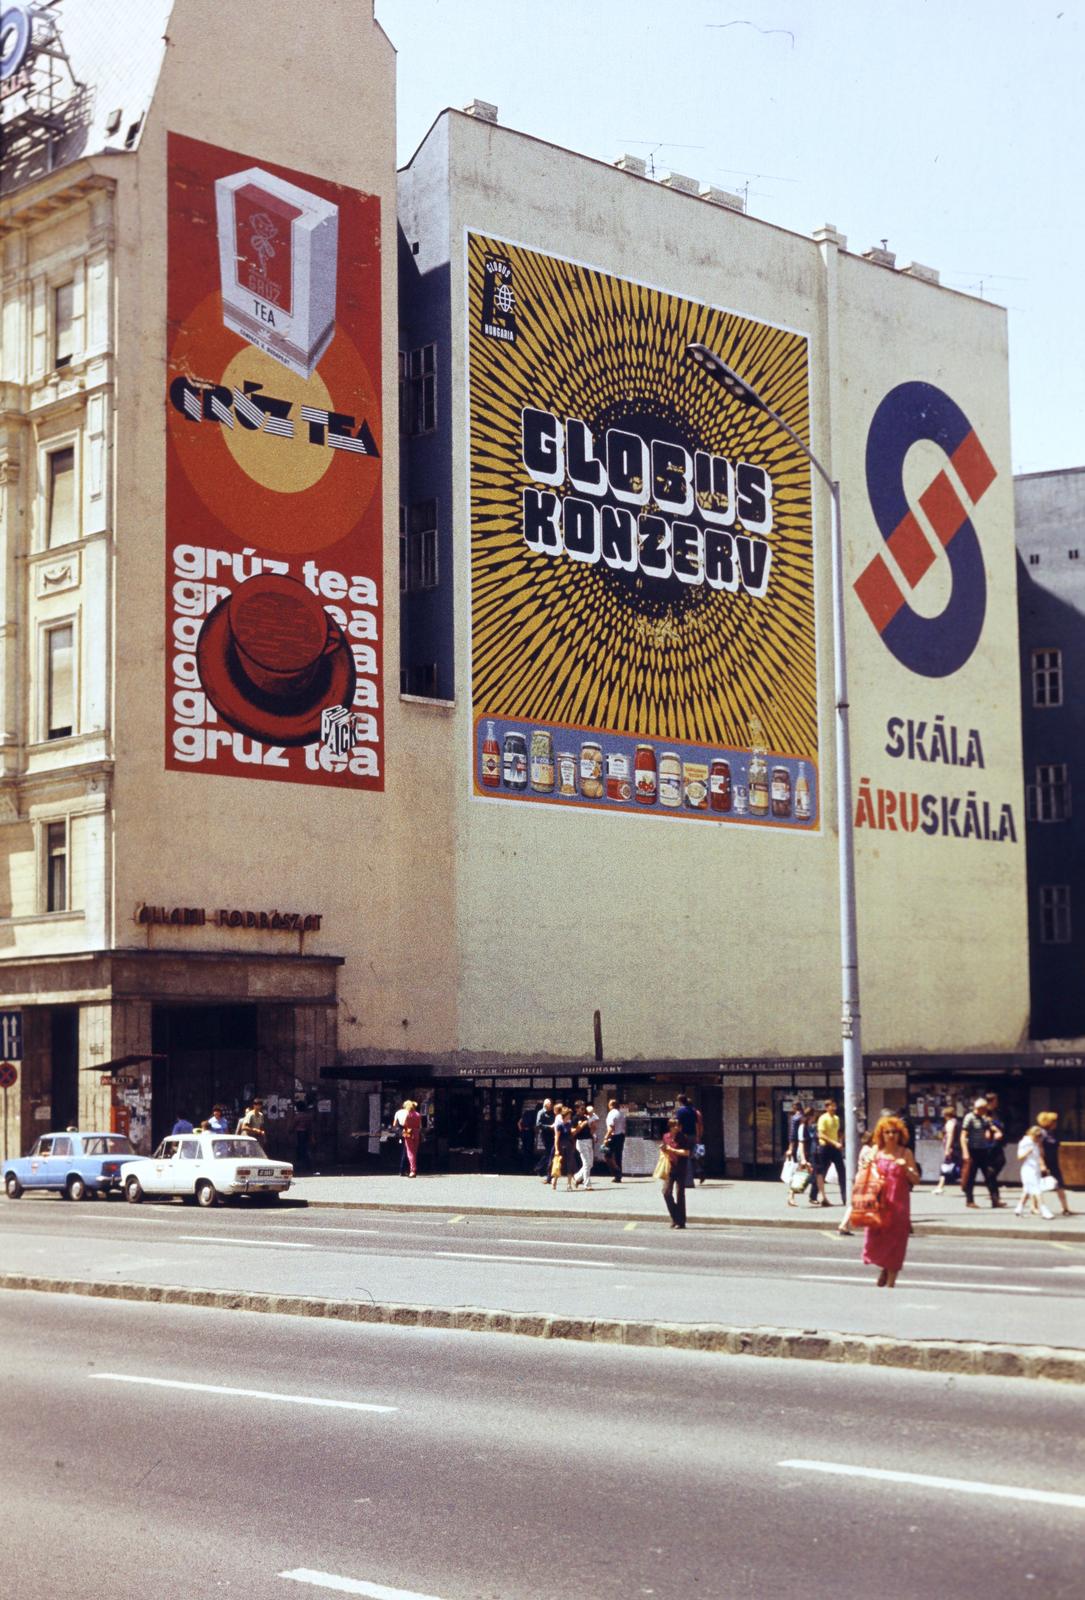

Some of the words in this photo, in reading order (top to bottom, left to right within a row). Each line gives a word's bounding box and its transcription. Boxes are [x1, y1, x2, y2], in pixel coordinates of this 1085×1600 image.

[486, 261, 511, 278] GLOBUS
[253, 300, 276, 327] TEA
[484, 323, 514, 341] HUNGARIA
[301, 405, 381, 459] TEA
[522, 406, 773, 536] GLOBUS
[522, 488, 773, 599] KONZERV
[302, 560, 379, 607] tea
[303, 743, 380, 777] tea
